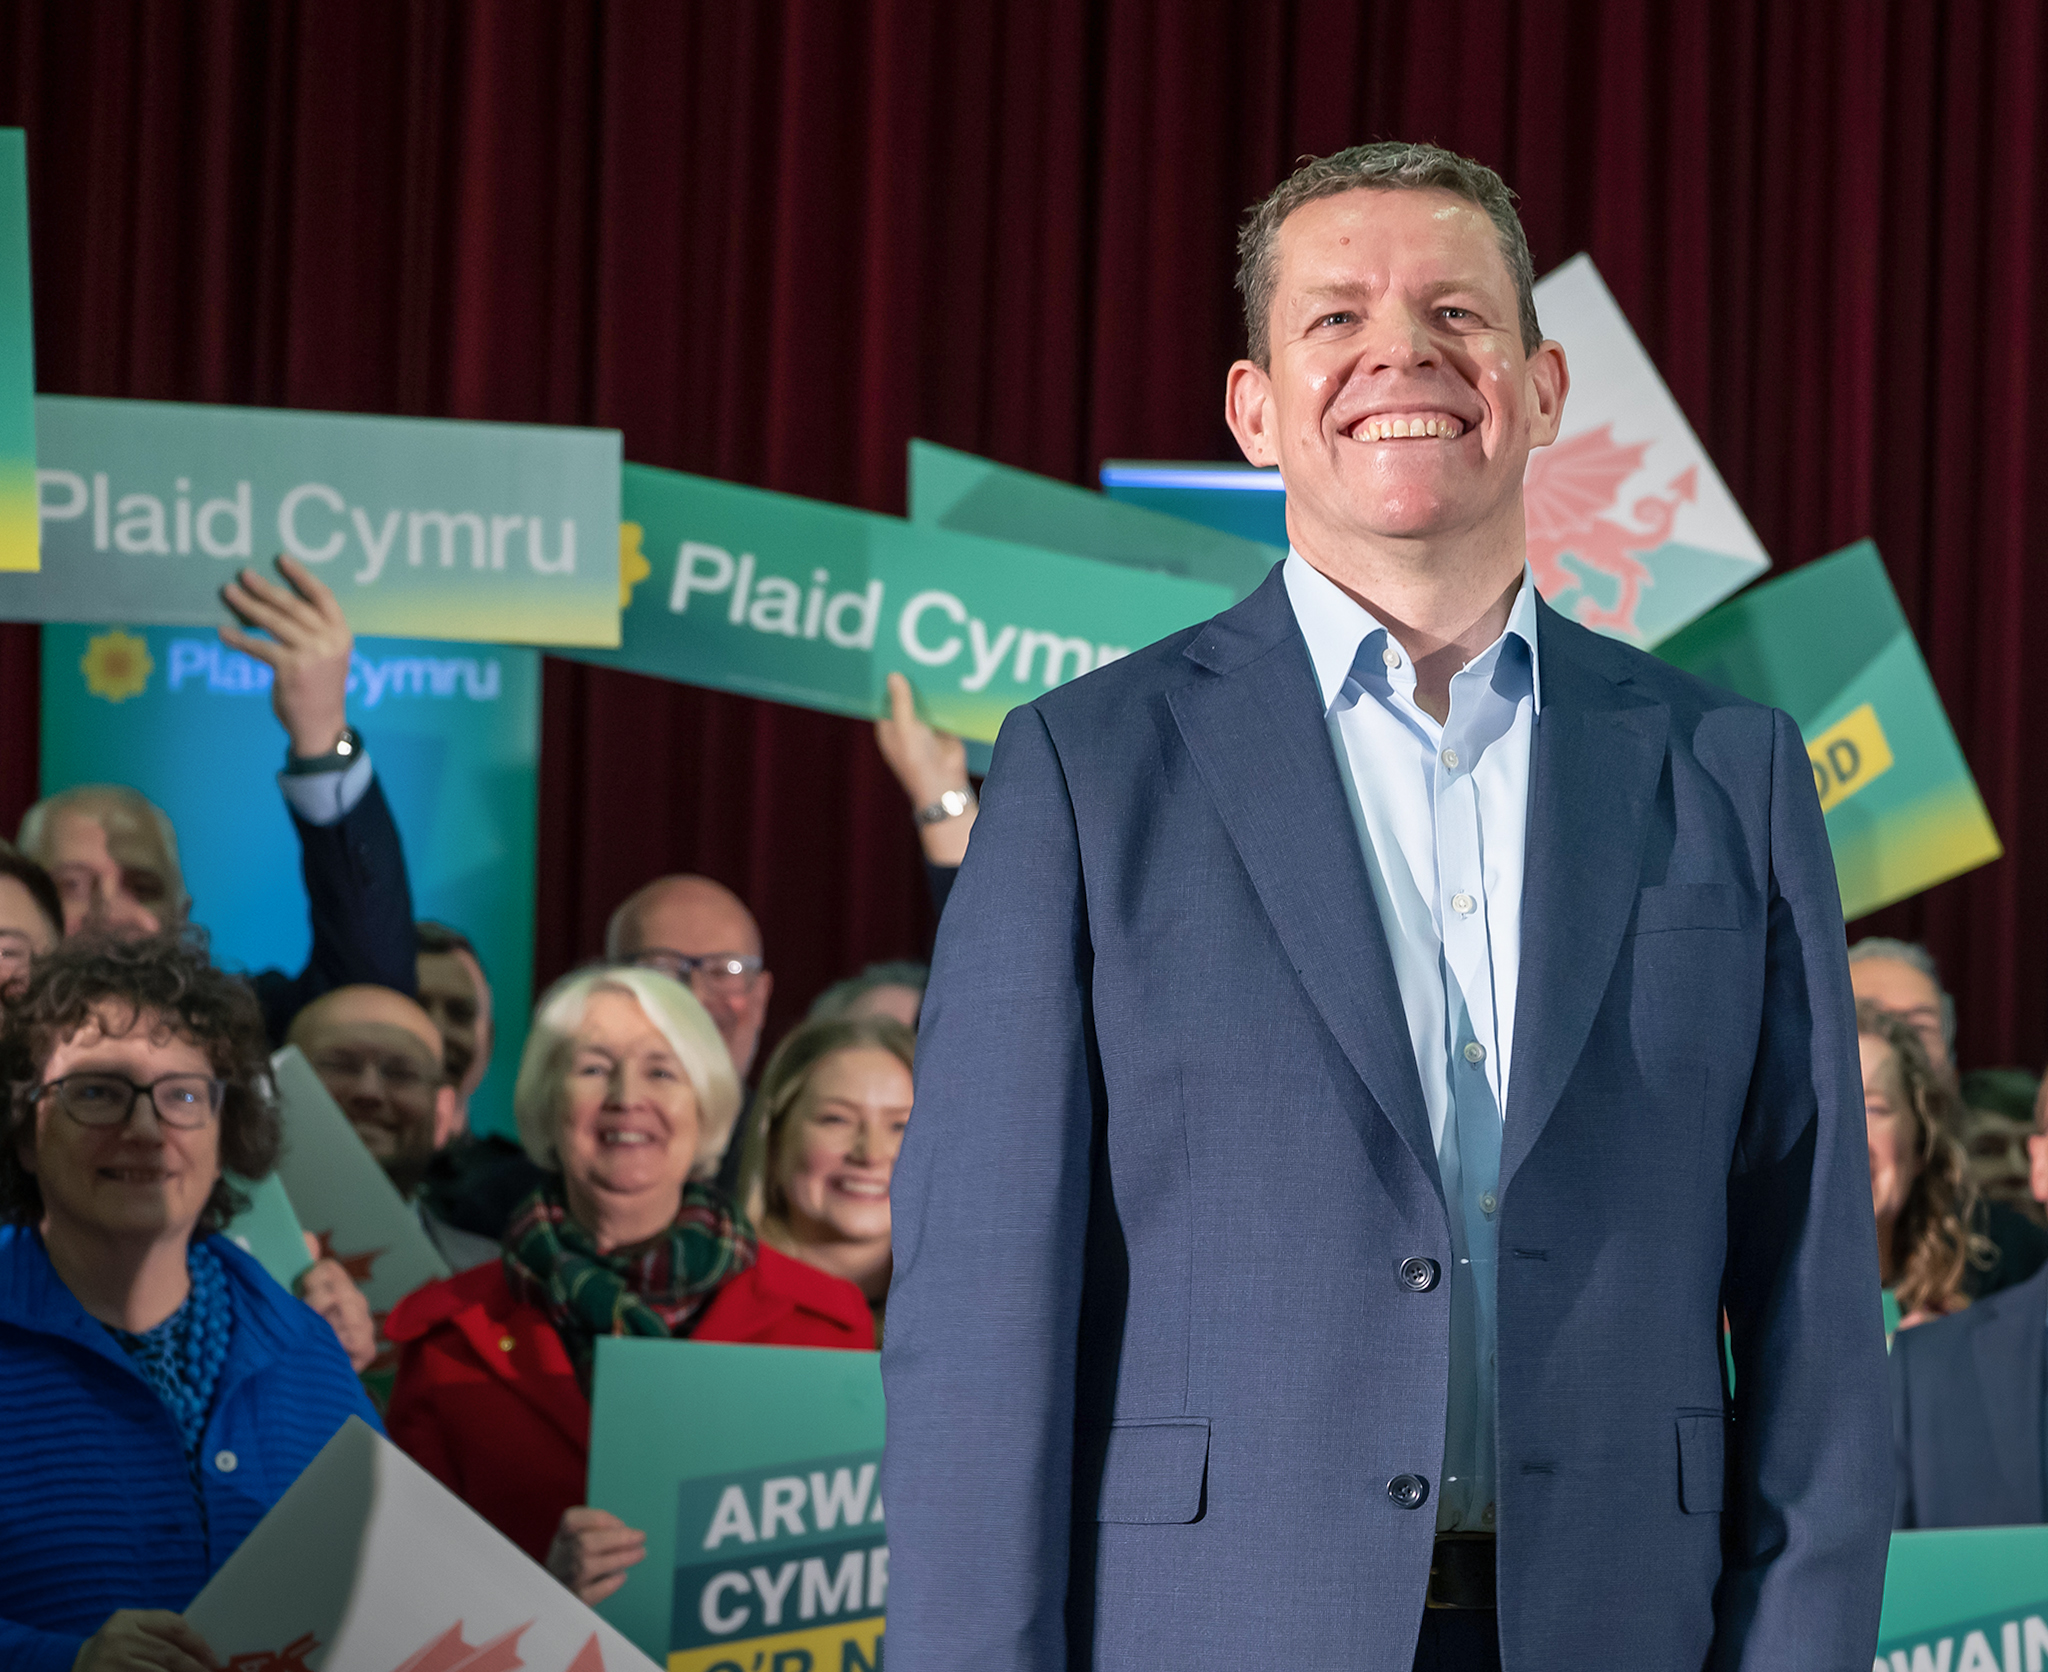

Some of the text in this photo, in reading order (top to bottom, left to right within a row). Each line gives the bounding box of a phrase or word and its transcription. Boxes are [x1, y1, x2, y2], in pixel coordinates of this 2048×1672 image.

[36, 468, 578, 584] Plaid Cymru
[668, 540, 885, 650] Plaid
[345, 652, 500, 707] ymru
[702, 1462, 884, 1551] ARW
